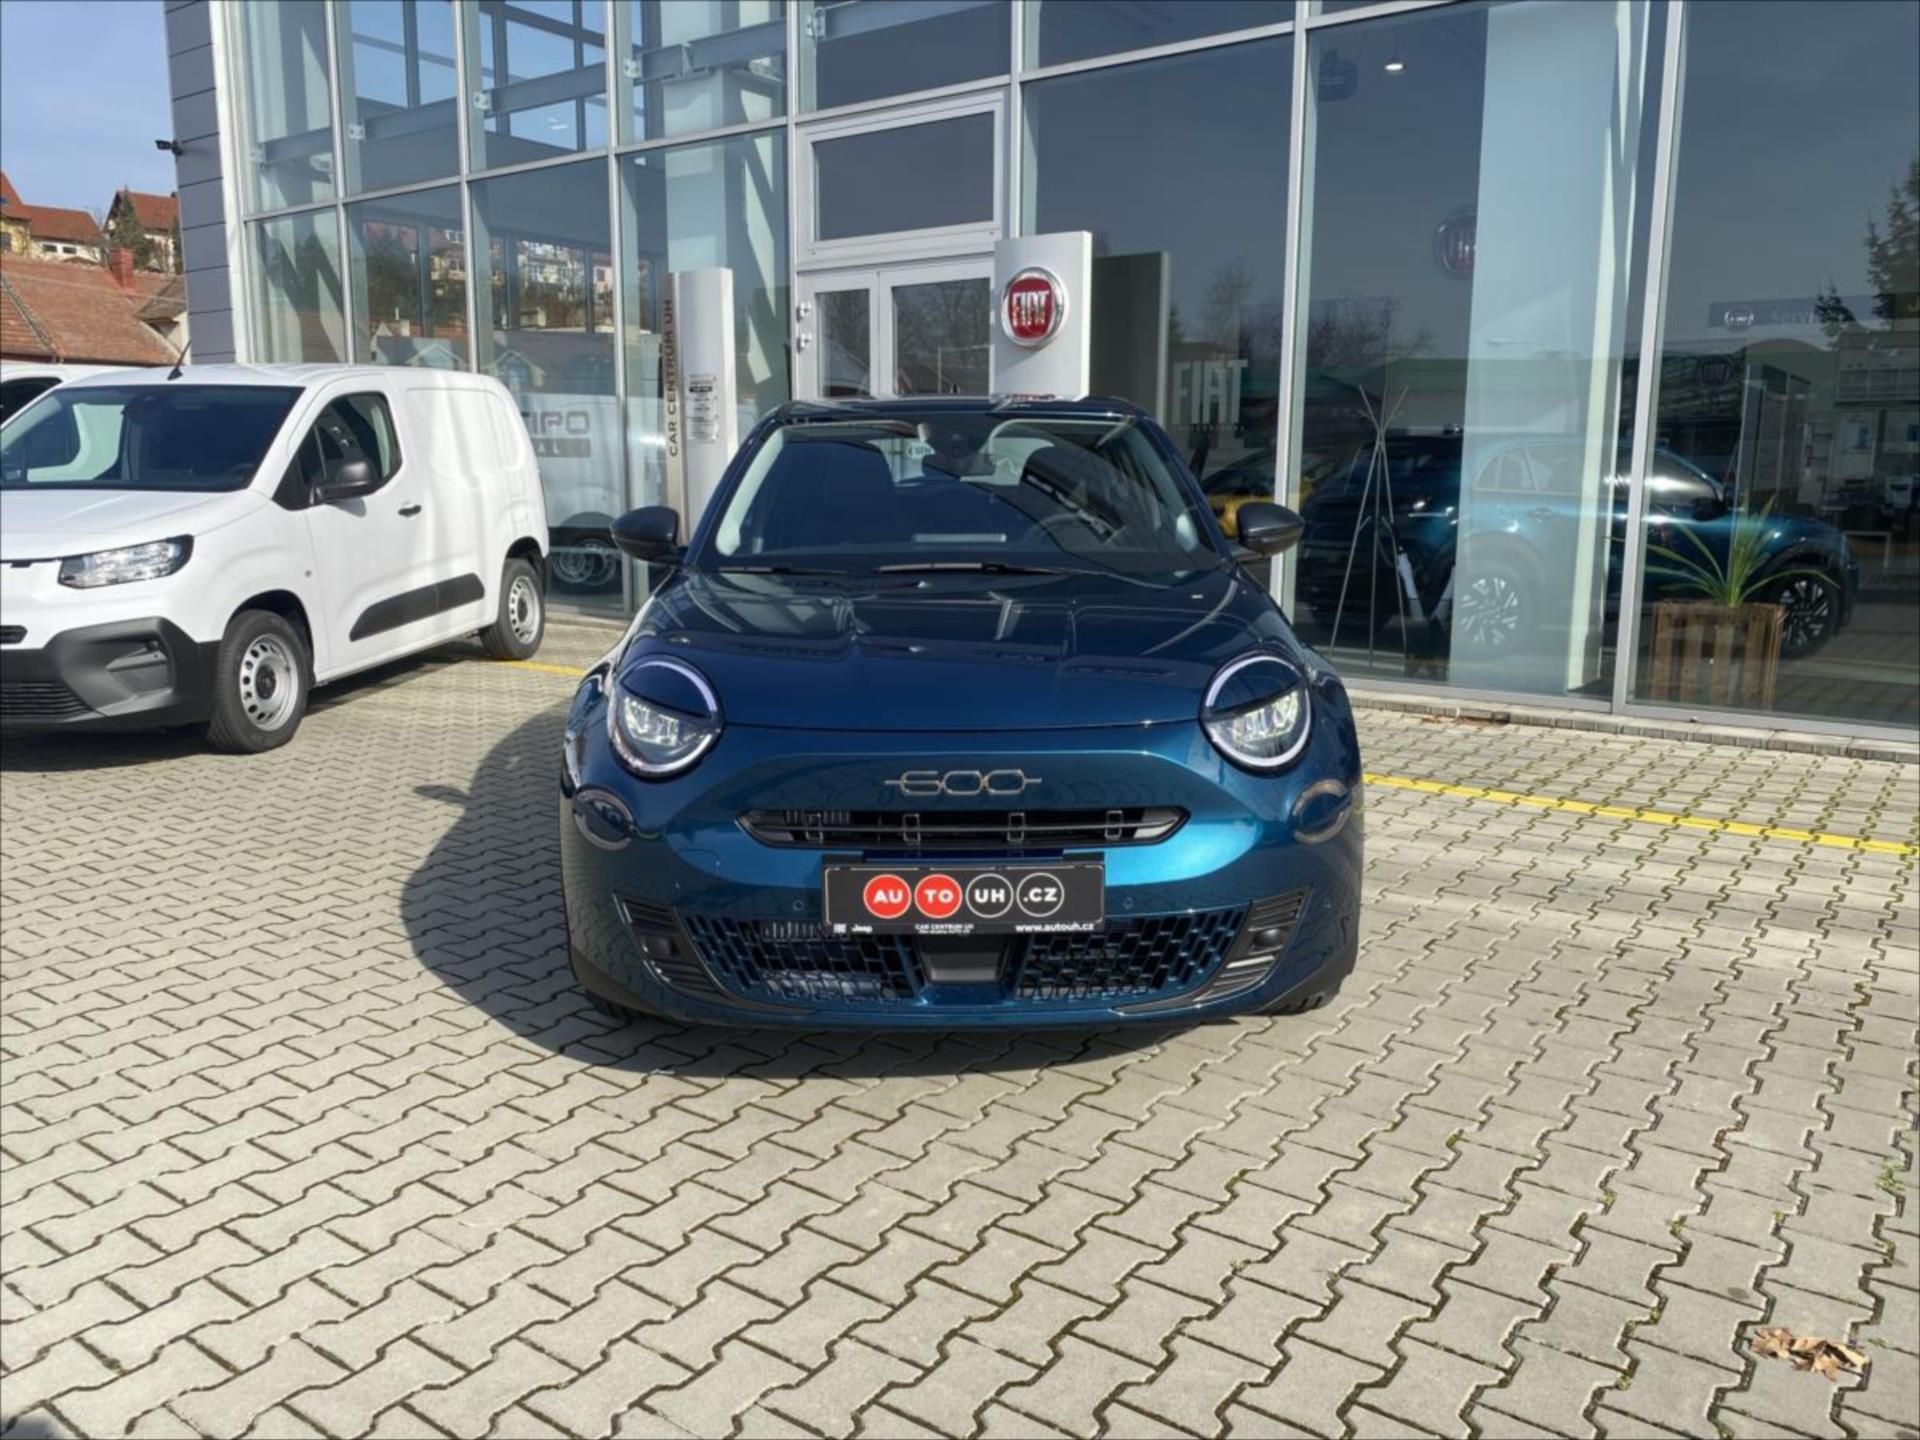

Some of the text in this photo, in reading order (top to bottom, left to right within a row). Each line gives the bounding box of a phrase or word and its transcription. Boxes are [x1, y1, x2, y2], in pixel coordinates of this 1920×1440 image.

[1011, 289, 1050, 327] FIAT
[664, 300, 678, 457] CAR CENTRUM UH
[1171, 359, 1249, 424] FIAT
[897, 768, 1029, 796] 600
[1015, 922, 1094, 932] www.autouh.cz
